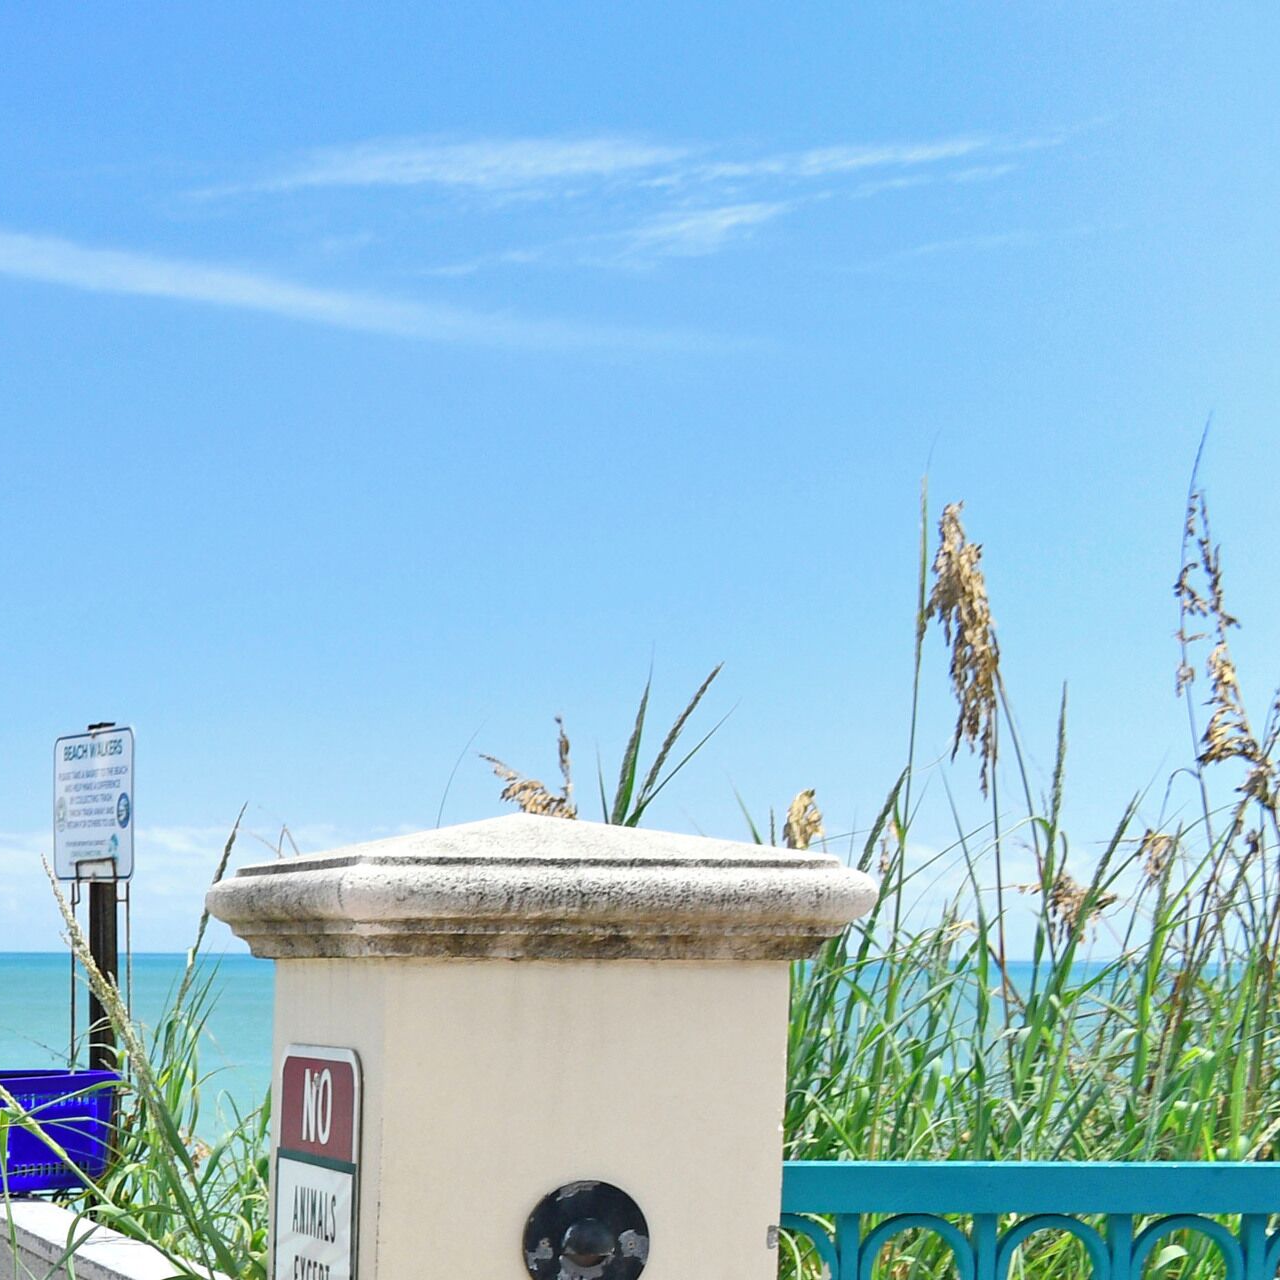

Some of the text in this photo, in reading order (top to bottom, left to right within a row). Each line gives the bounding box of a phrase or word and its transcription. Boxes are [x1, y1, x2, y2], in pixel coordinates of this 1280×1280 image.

[63, 743, 88, 761] BEACH
[302, 1068, 332, 1145] NO
[292, 1185, 336, 1244] ANIMALS
